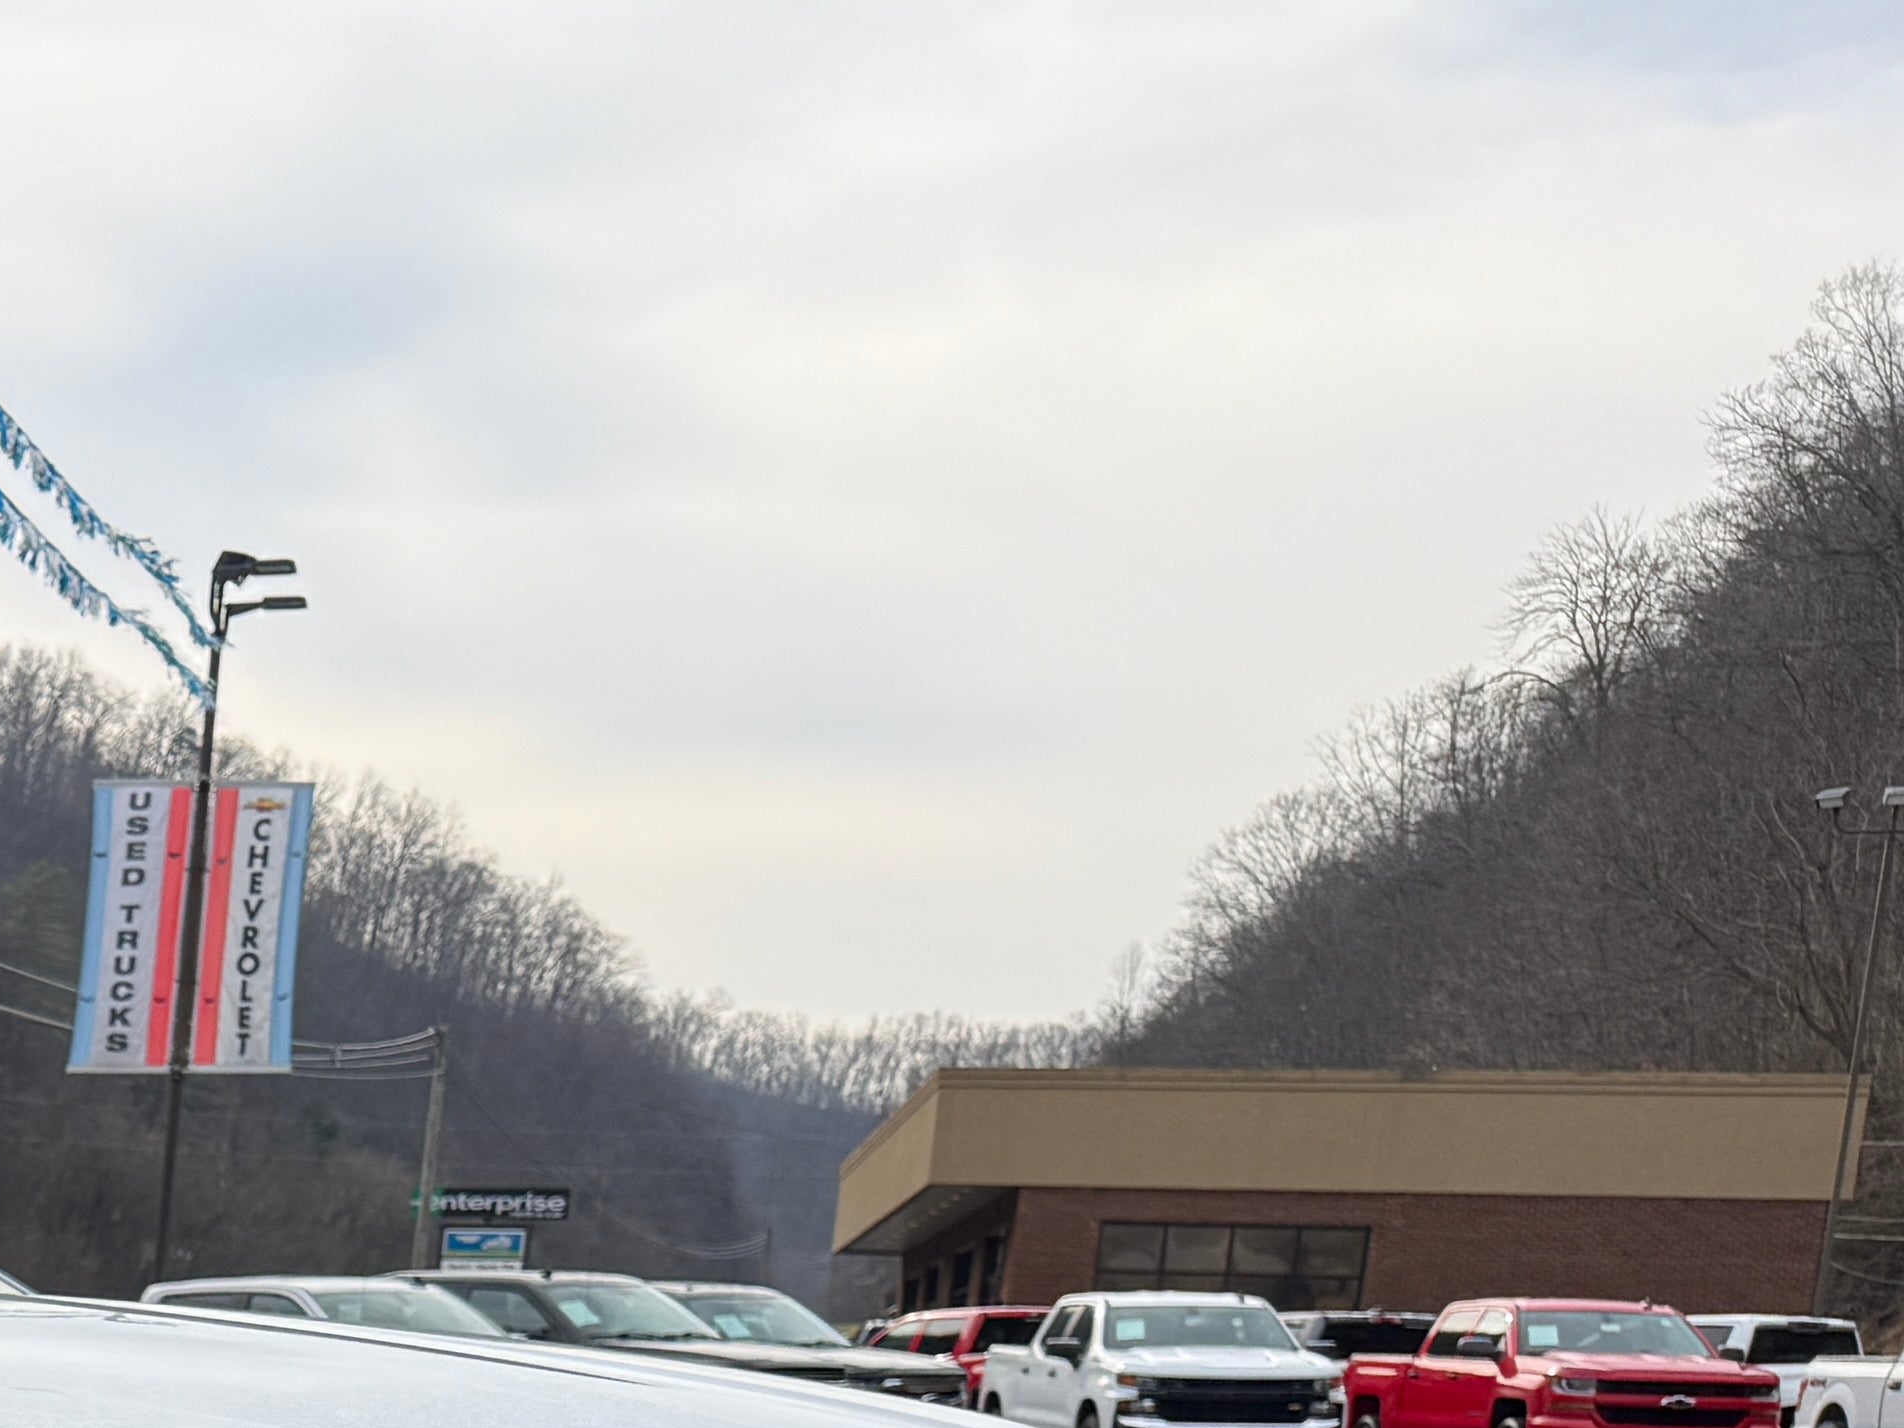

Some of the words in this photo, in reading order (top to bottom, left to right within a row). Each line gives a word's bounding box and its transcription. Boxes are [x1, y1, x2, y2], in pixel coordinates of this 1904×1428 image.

[120, 791, 152, 888] USED
[104, 903, 141, 1053] TRUCKS
[236, 817, 272, 1057] CHEVROLET
